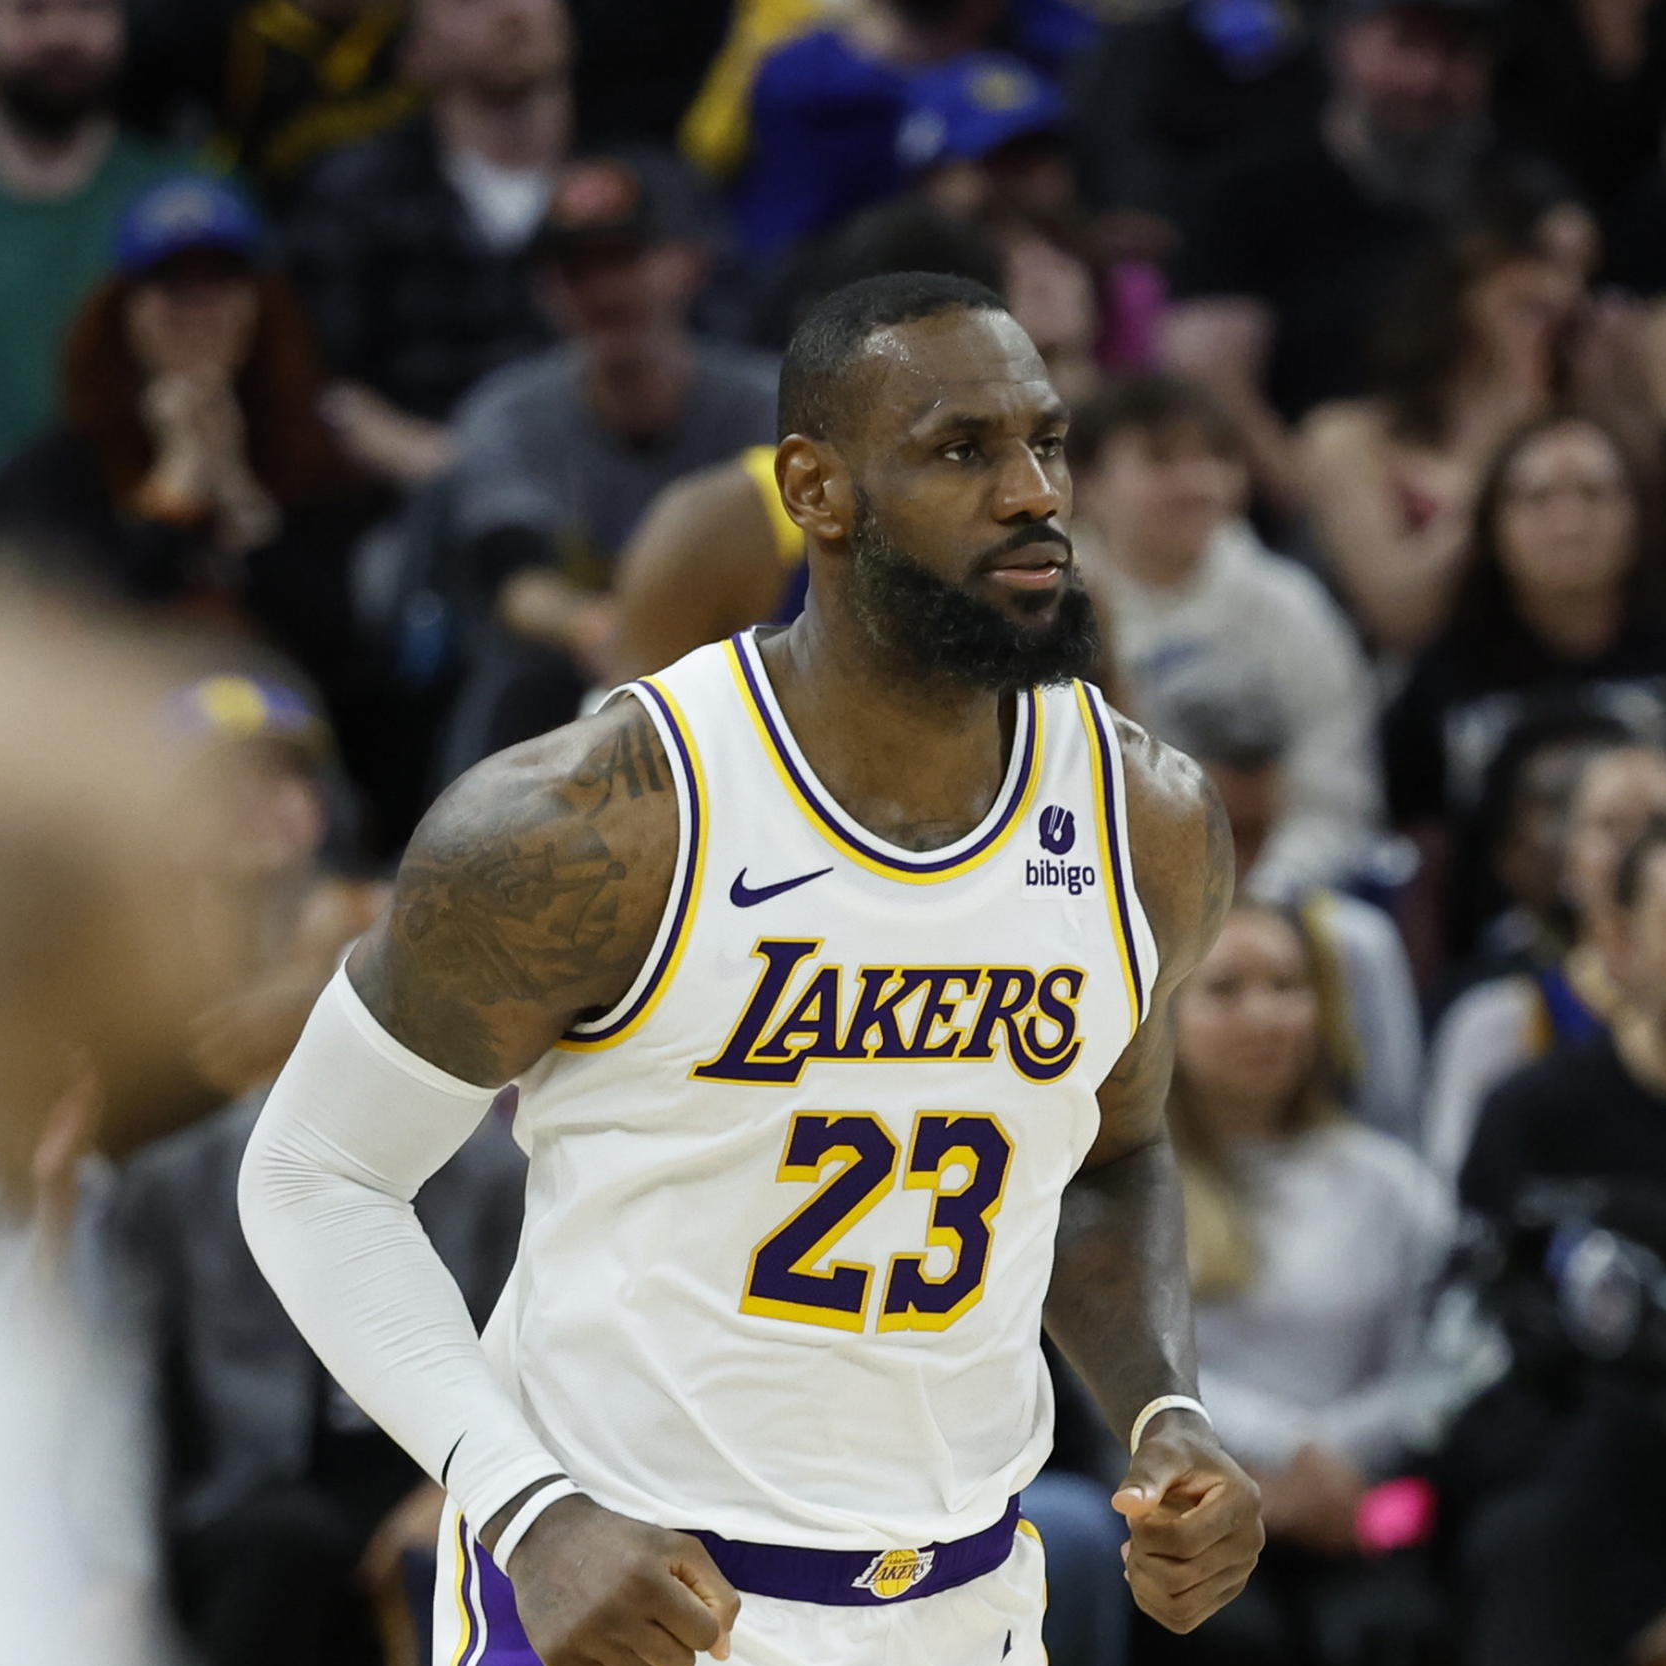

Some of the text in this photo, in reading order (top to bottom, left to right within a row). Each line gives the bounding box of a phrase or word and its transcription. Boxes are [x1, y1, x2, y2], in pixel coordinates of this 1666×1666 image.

[1026, 859, 1095, 895] bibigo
[687, 936, 1089, 1087] LAKERS
[738, 1109, 1015, 1334] 23
[857, 1556, 932, 1586] LAKERS
